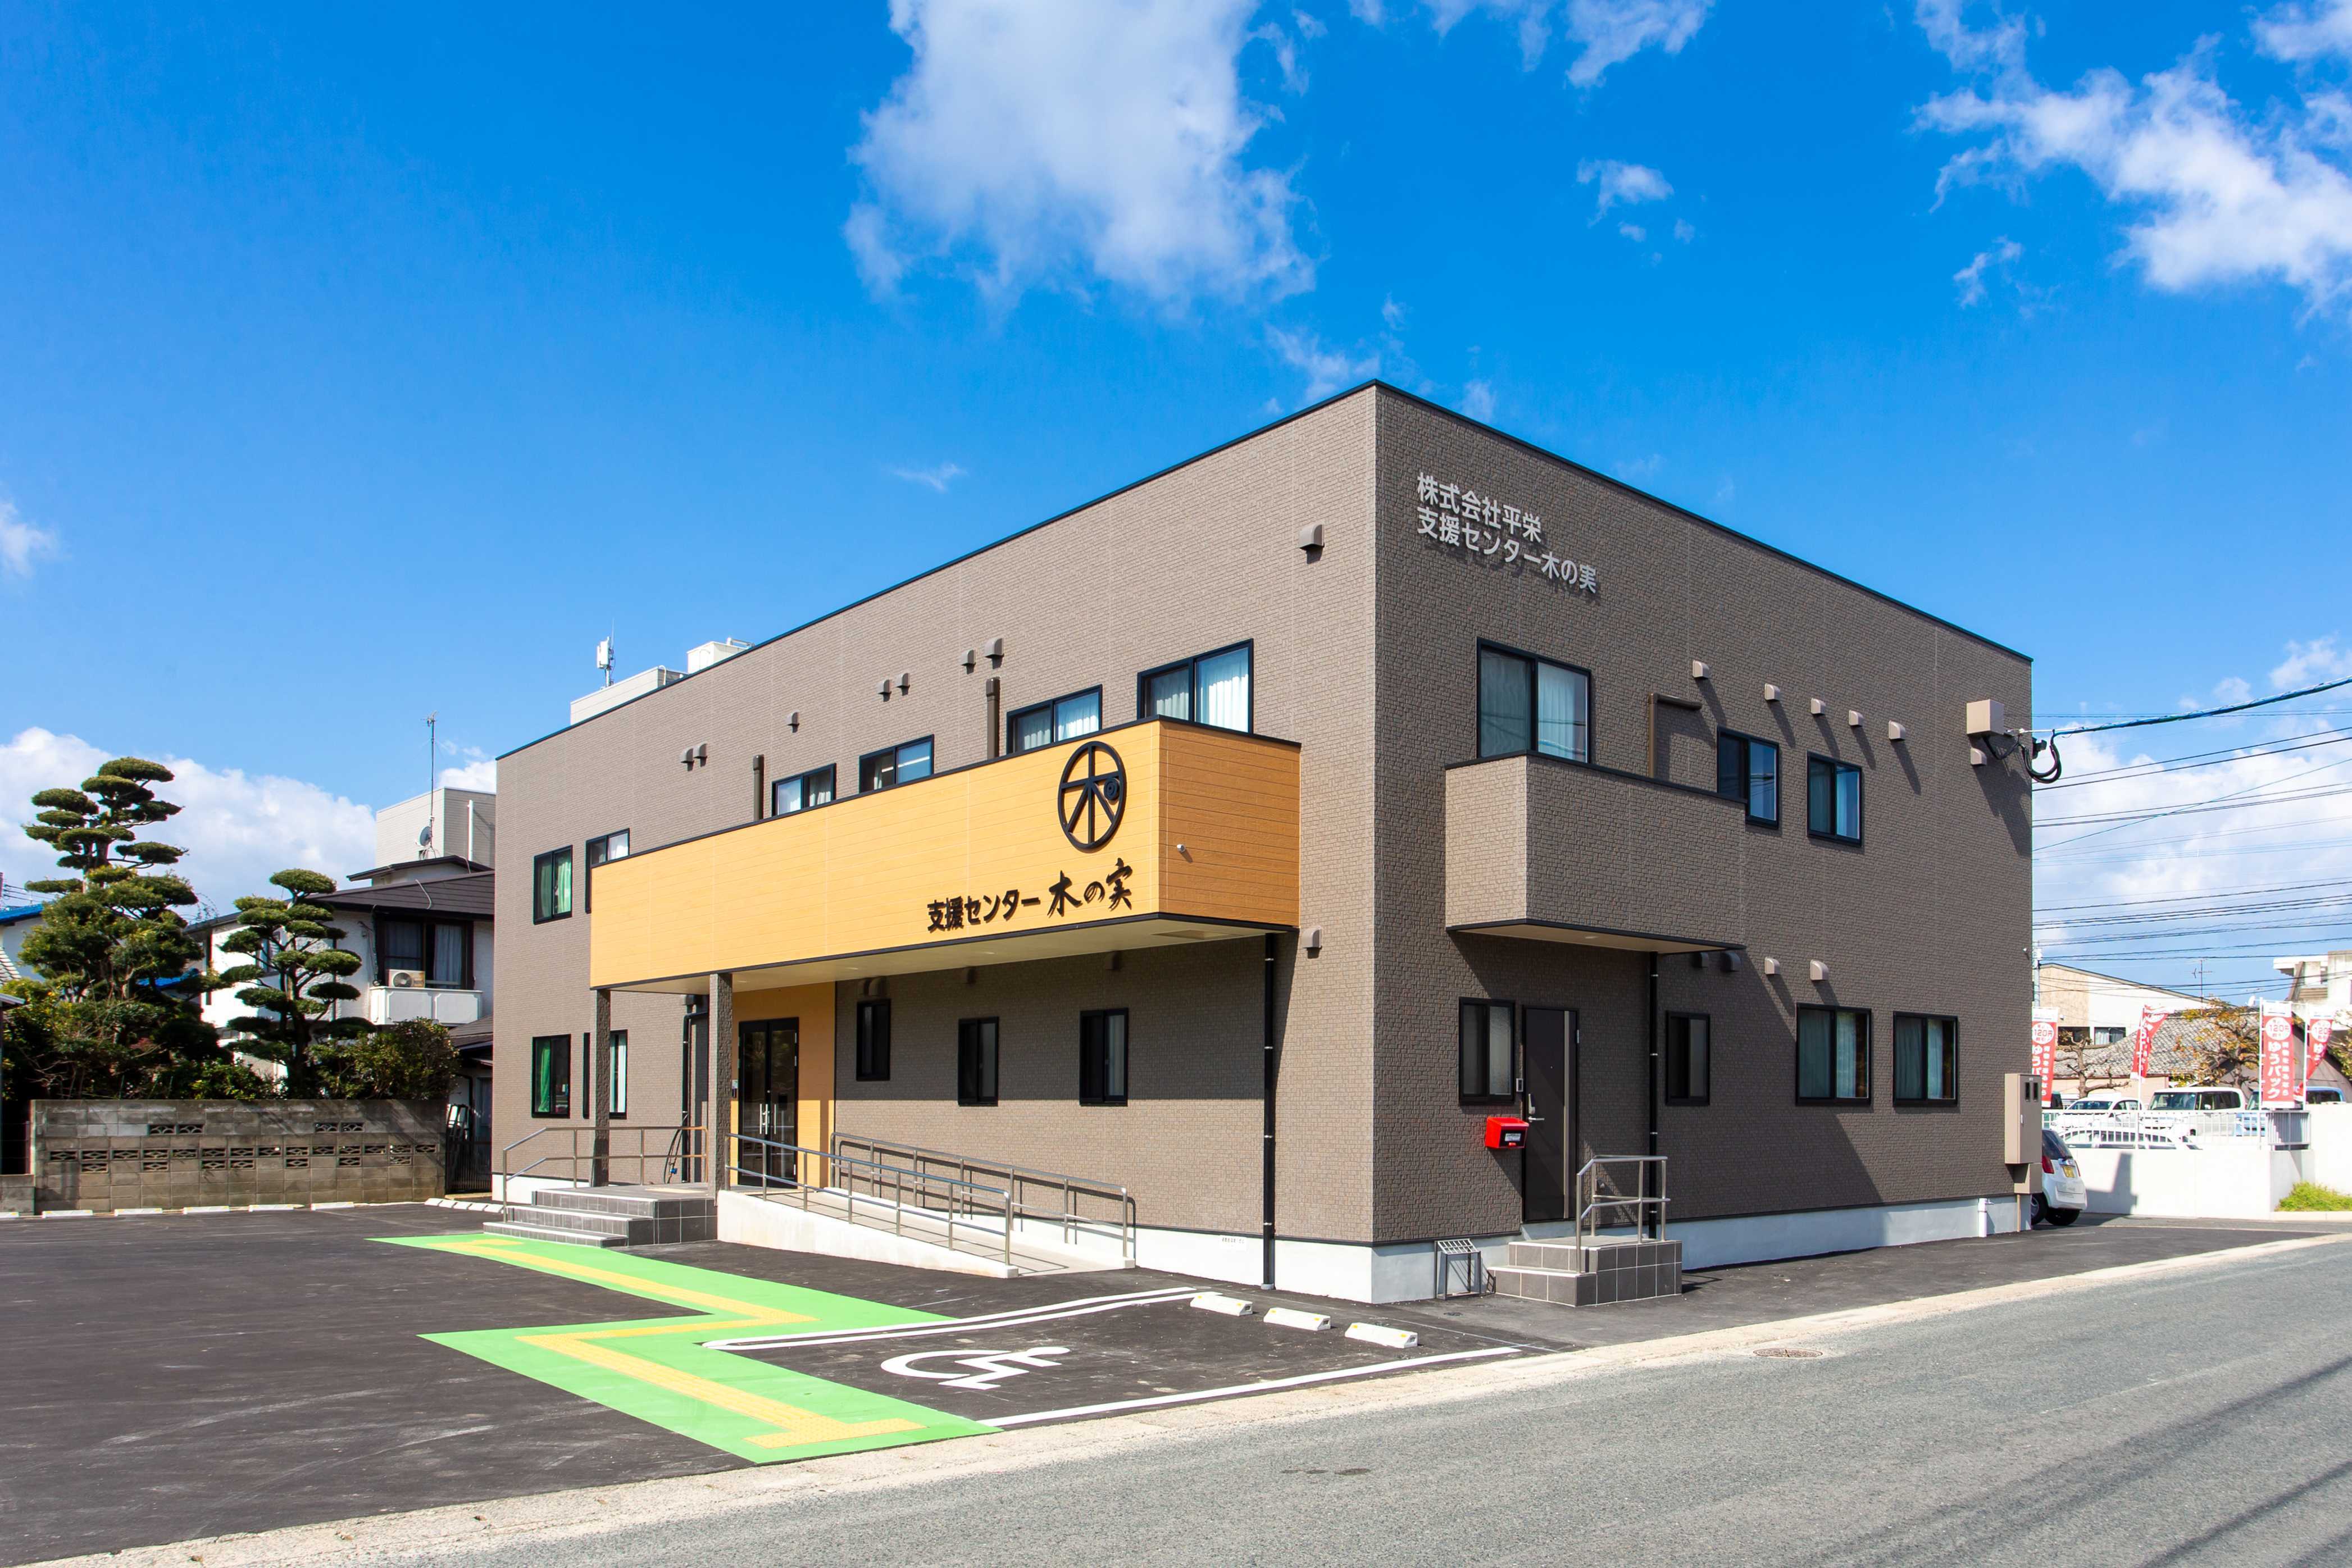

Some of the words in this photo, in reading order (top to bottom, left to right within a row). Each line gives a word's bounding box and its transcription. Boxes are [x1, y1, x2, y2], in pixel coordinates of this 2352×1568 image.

[1417, 472, 1541, 543] 株式会社平栄
[1417, 506, 1596, 594] 支援センター木の実
[927, 889, 1040, 933] 支援センター
[1048, 857, 1133, 917] 木の実
[2267, 1041, 2282, 1099] ゆうパック
